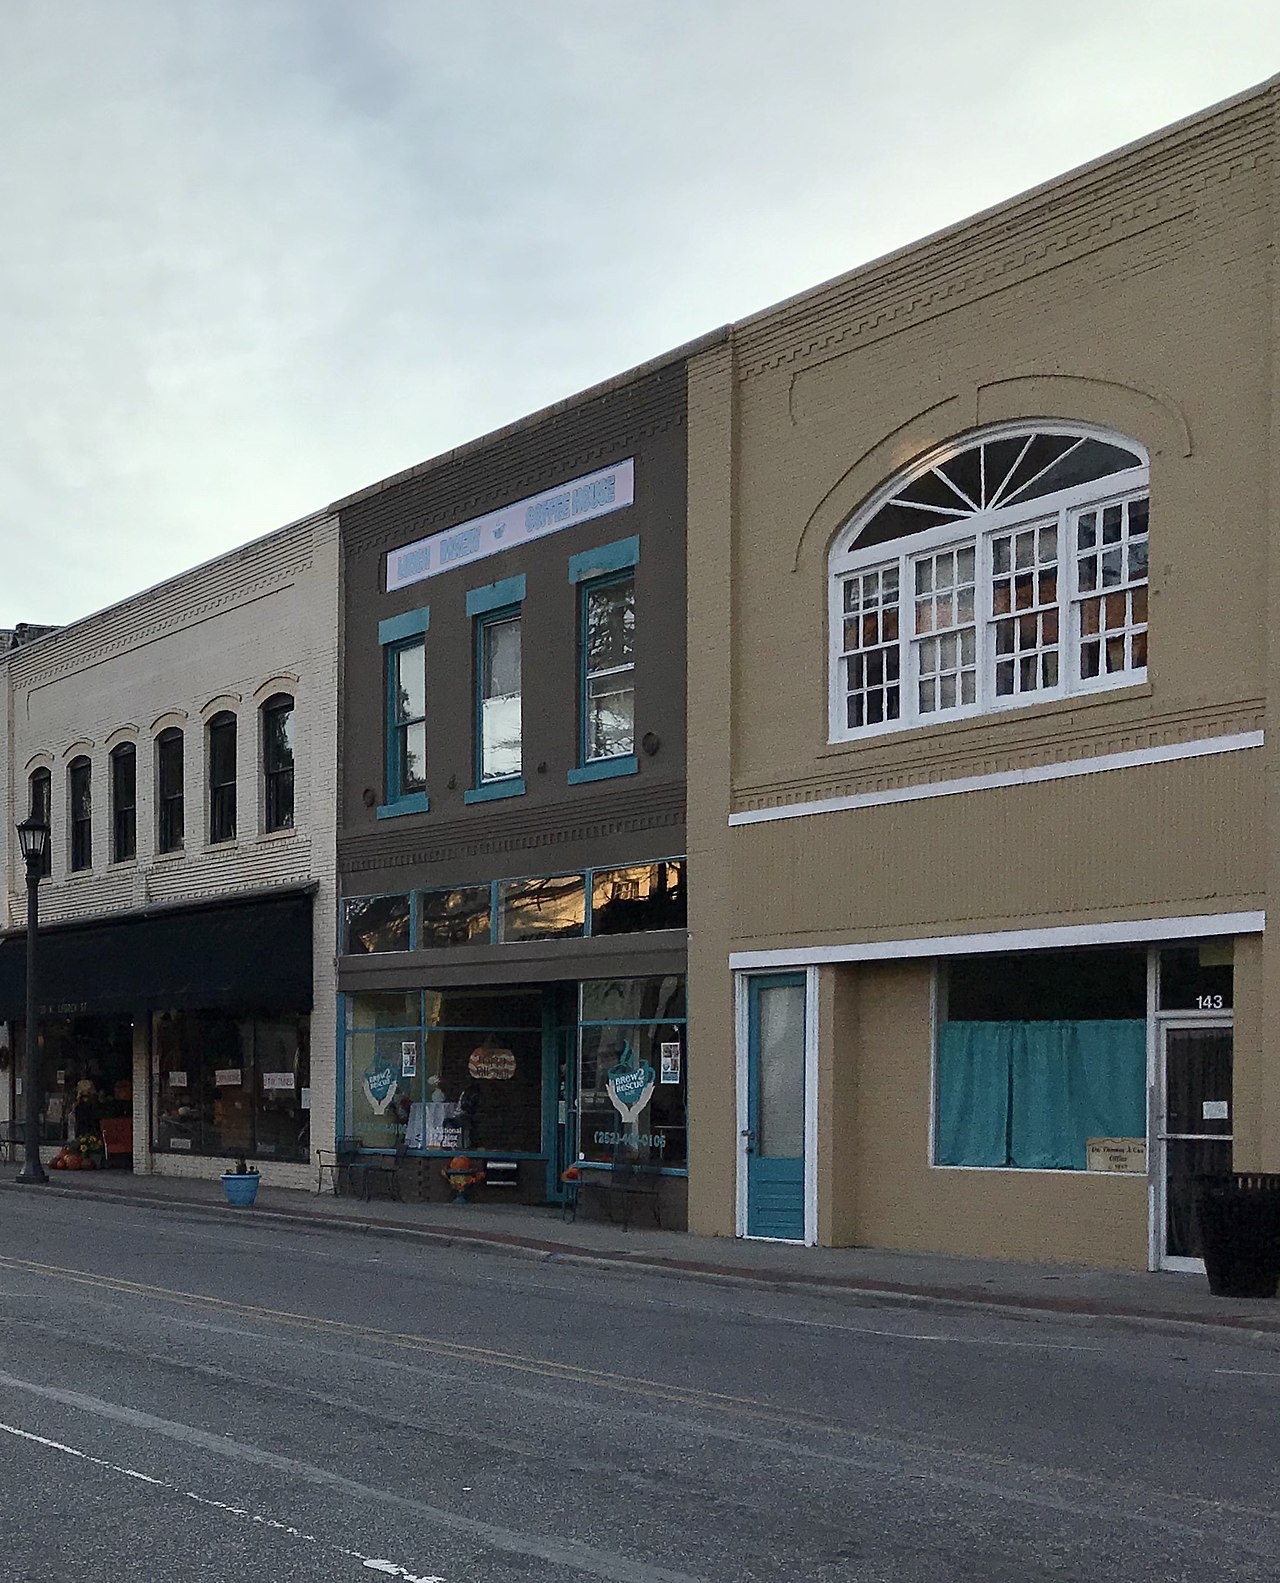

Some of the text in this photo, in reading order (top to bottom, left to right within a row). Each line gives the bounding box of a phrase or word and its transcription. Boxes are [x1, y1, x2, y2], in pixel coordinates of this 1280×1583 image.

[524, 491, 570, 533] COFFEE
[571, 474, 616, 517] HOUSE
[1195, 994, 1223, 1009] 143
